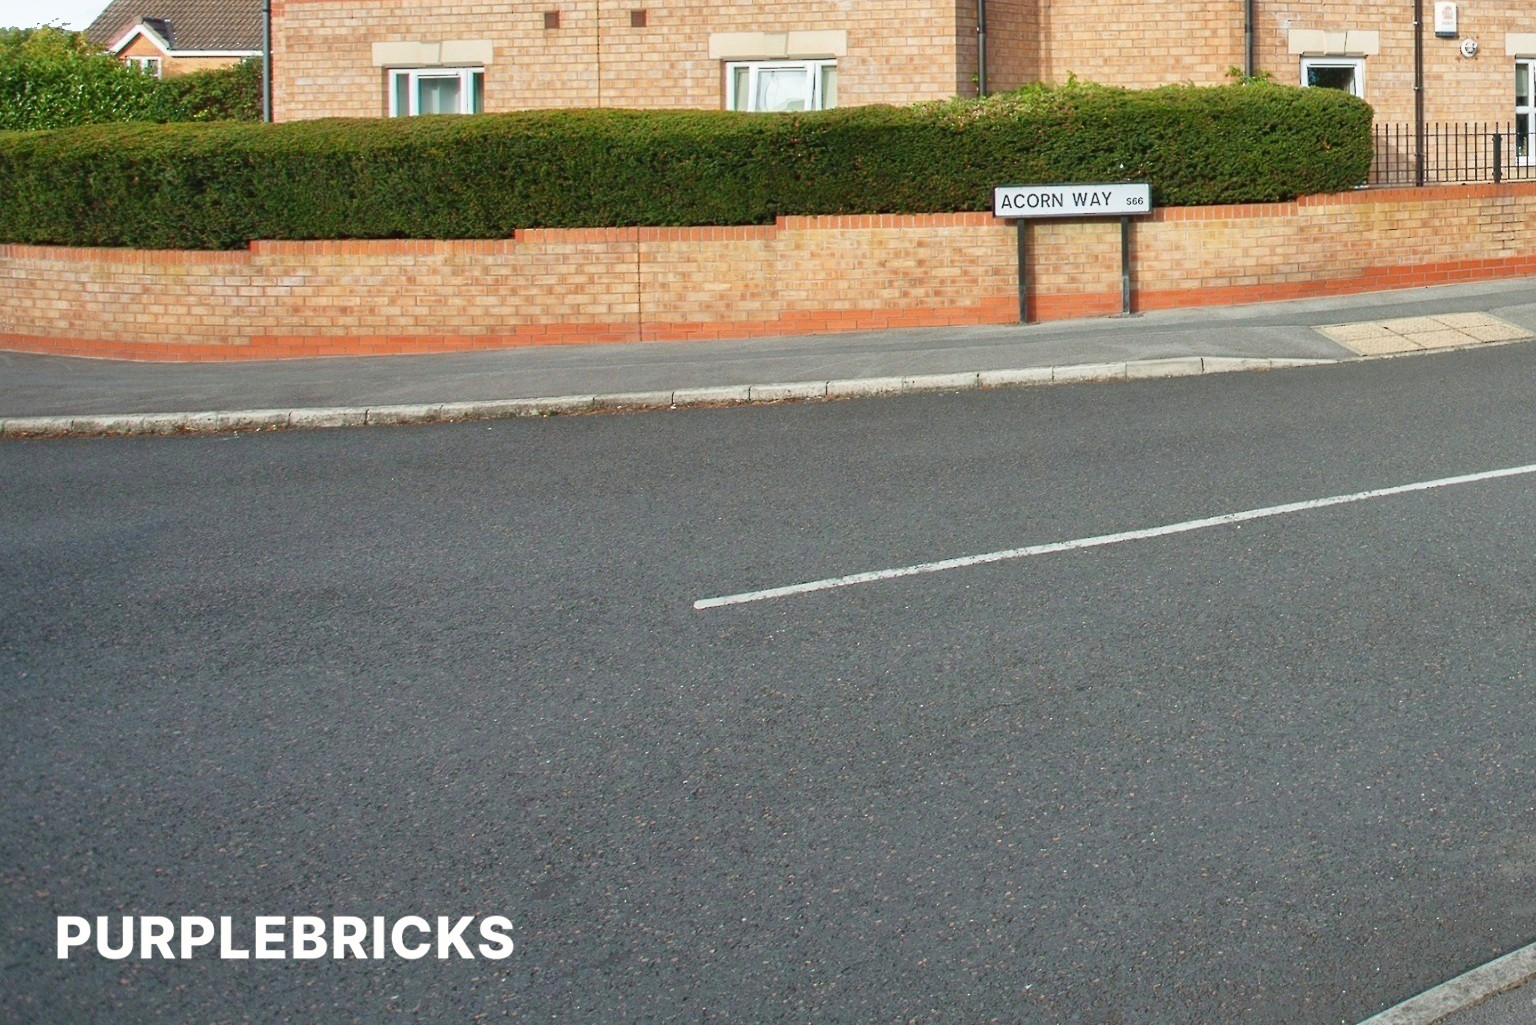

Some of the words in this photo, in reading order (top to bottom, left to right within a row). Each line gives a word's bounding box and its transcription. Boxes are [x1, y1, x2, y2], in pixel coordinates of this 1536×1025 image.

[1001, 193, 1063, 209] ACORN
[1072, 191, 1112, 207] WAY
[1126, 196, 1144, 206] S66
